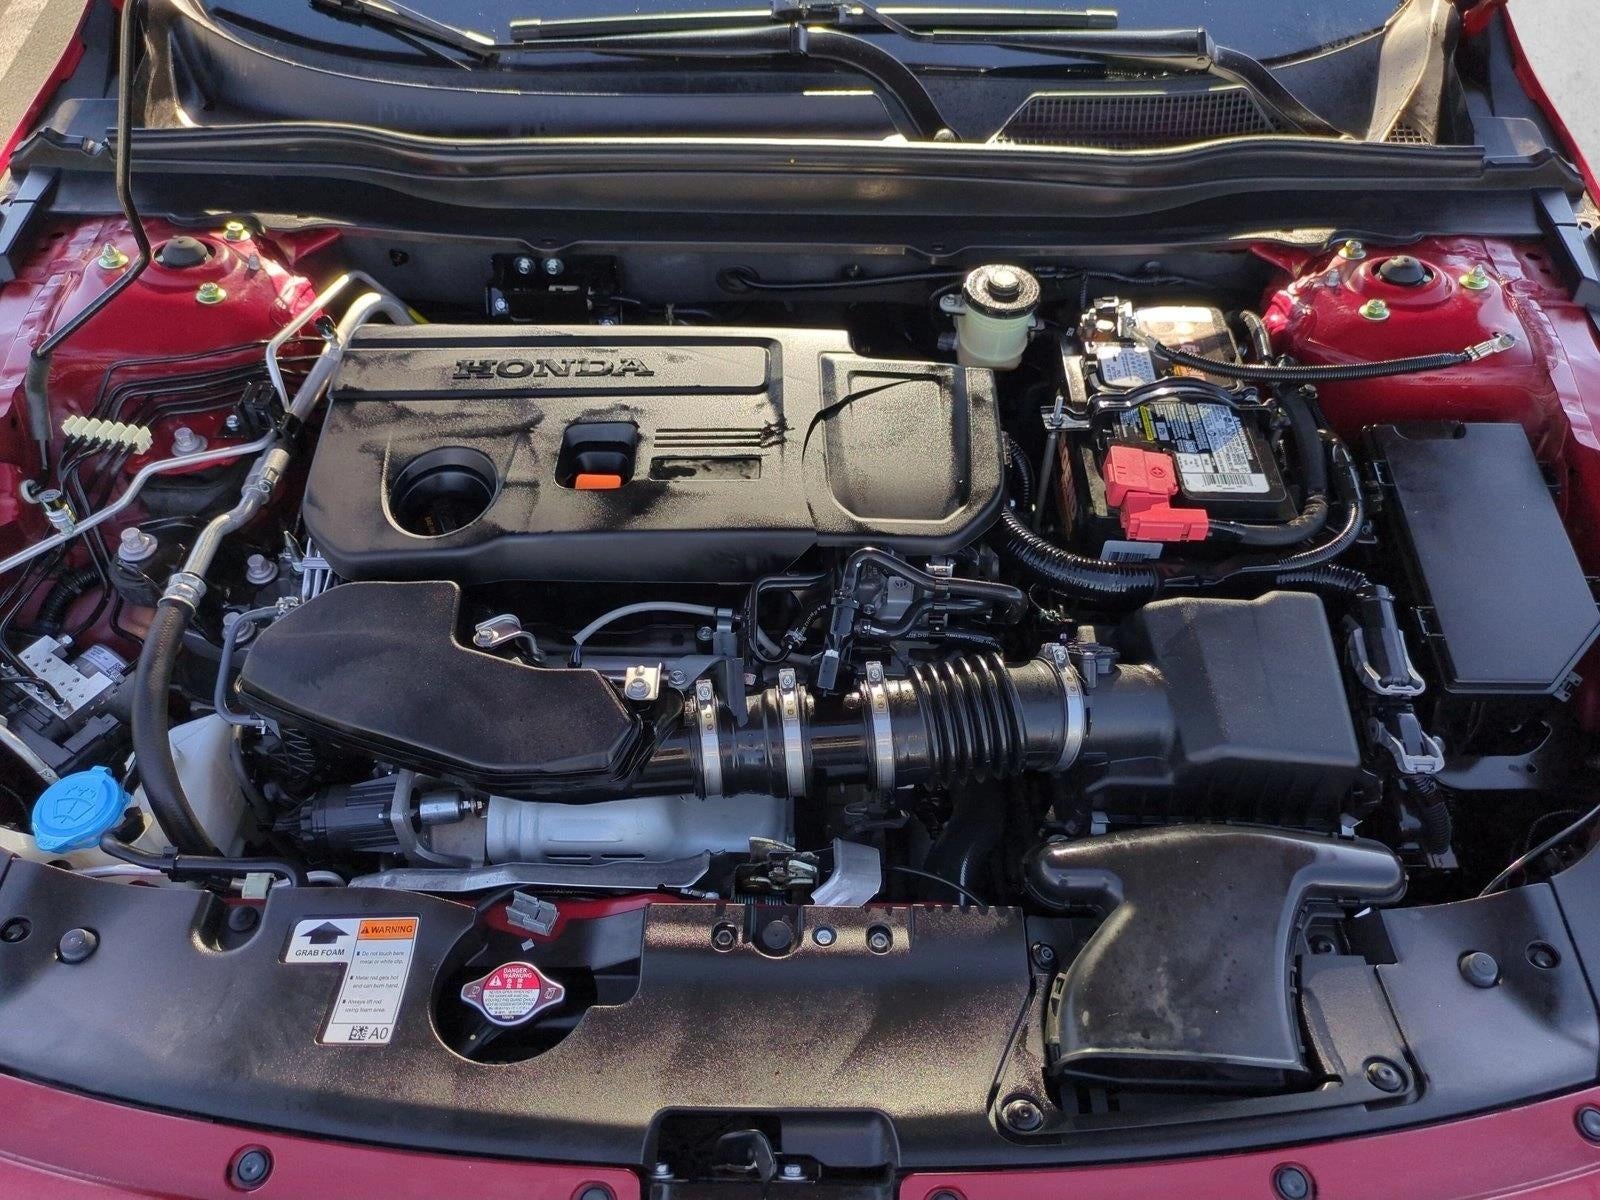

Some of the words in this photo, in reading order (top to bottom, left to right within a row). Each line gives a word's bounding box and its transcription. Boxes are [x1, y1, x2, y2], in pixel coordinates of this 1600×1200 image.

[452, 358, 655, 379] HONDA
[371, 925, 413, 934] WARNING
[295, 949, 319, 957] GRAB
[320, 948, 345, 956] FOAM
[368, 1026, 389, 1040] A0
